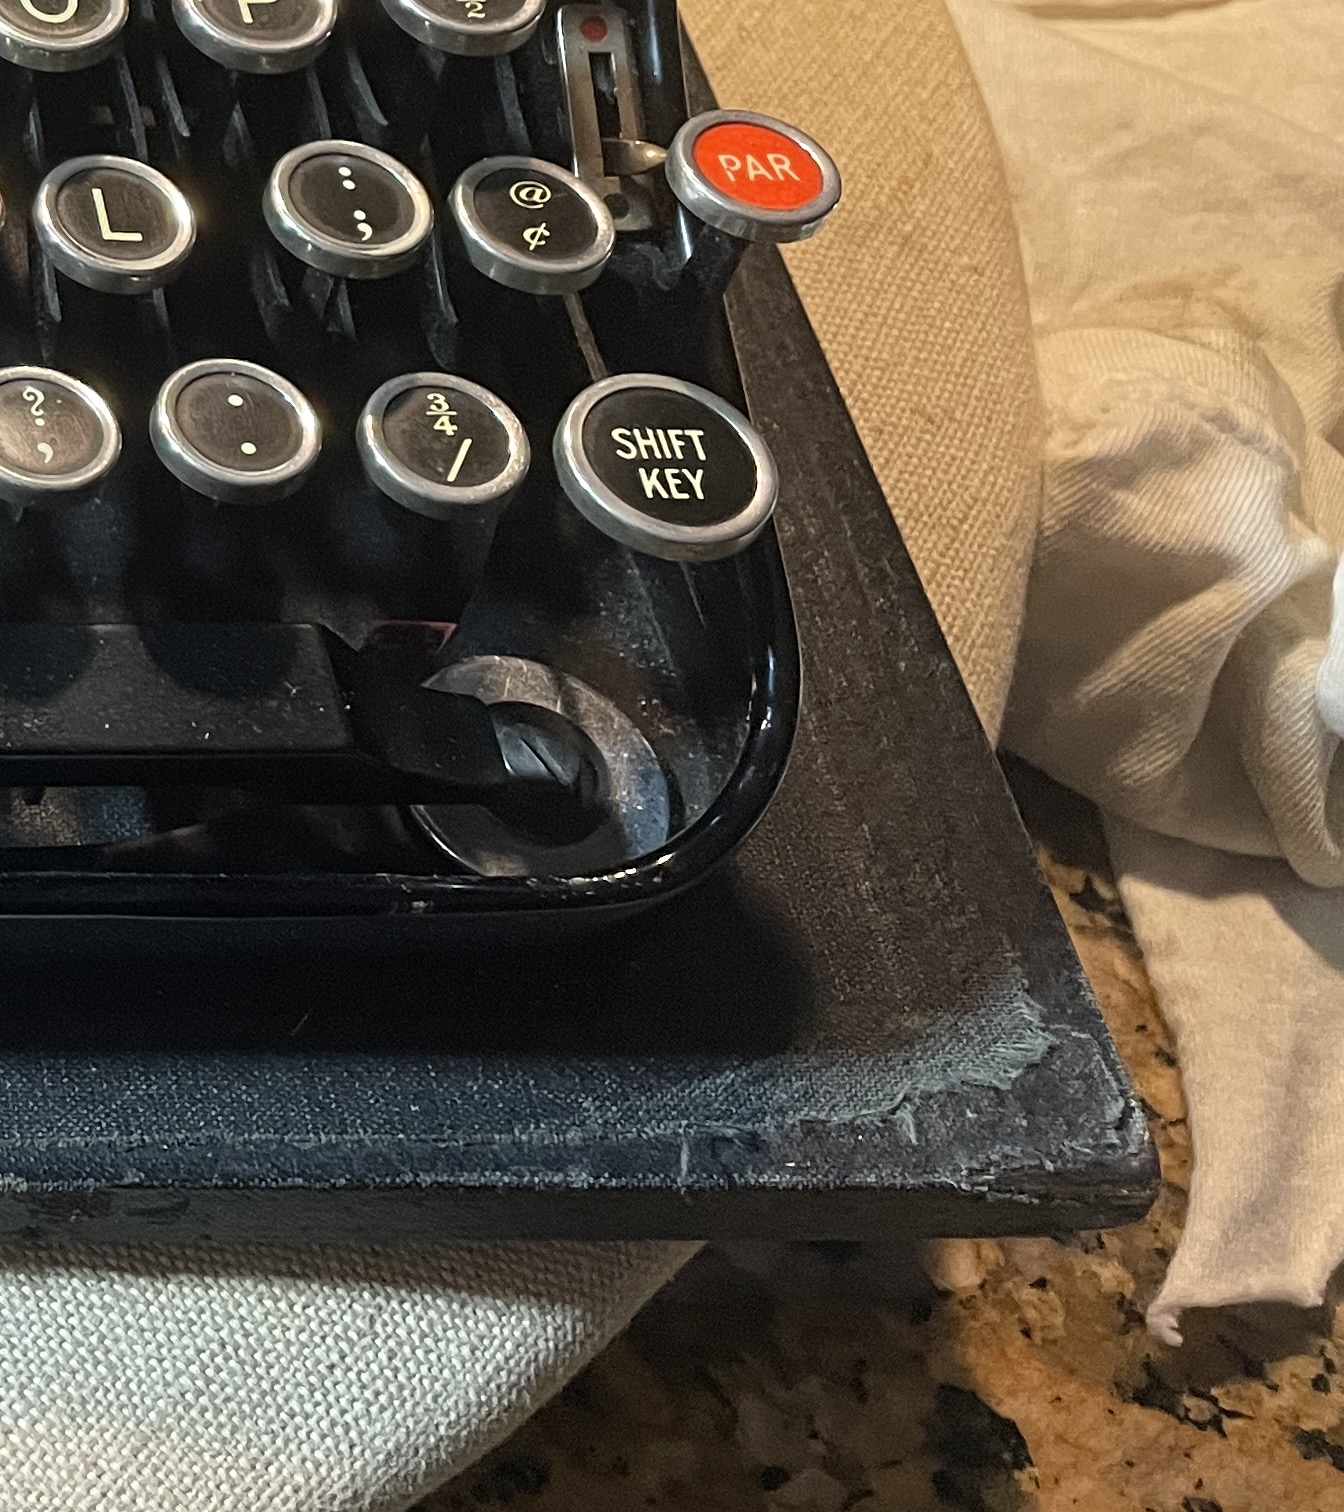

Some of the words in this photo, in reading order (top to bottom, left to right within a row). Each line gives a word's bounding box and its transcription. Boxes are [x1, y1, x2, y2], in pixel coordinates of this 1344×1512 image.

[339, 167, 355, 189] :
[716, 151, 802, 186] PAR
[510, 181, 551, 208] @
[92, 189, 142, 241] L
[354, 210, 372, 241] ;
[523, 223, 550, 250] ¢
[23, 386, 45, 426] ?
[611, 428, 706, 460] SHIFT
[447, 439, 472, 481] /
[639, 468, 704, 499] KEY
